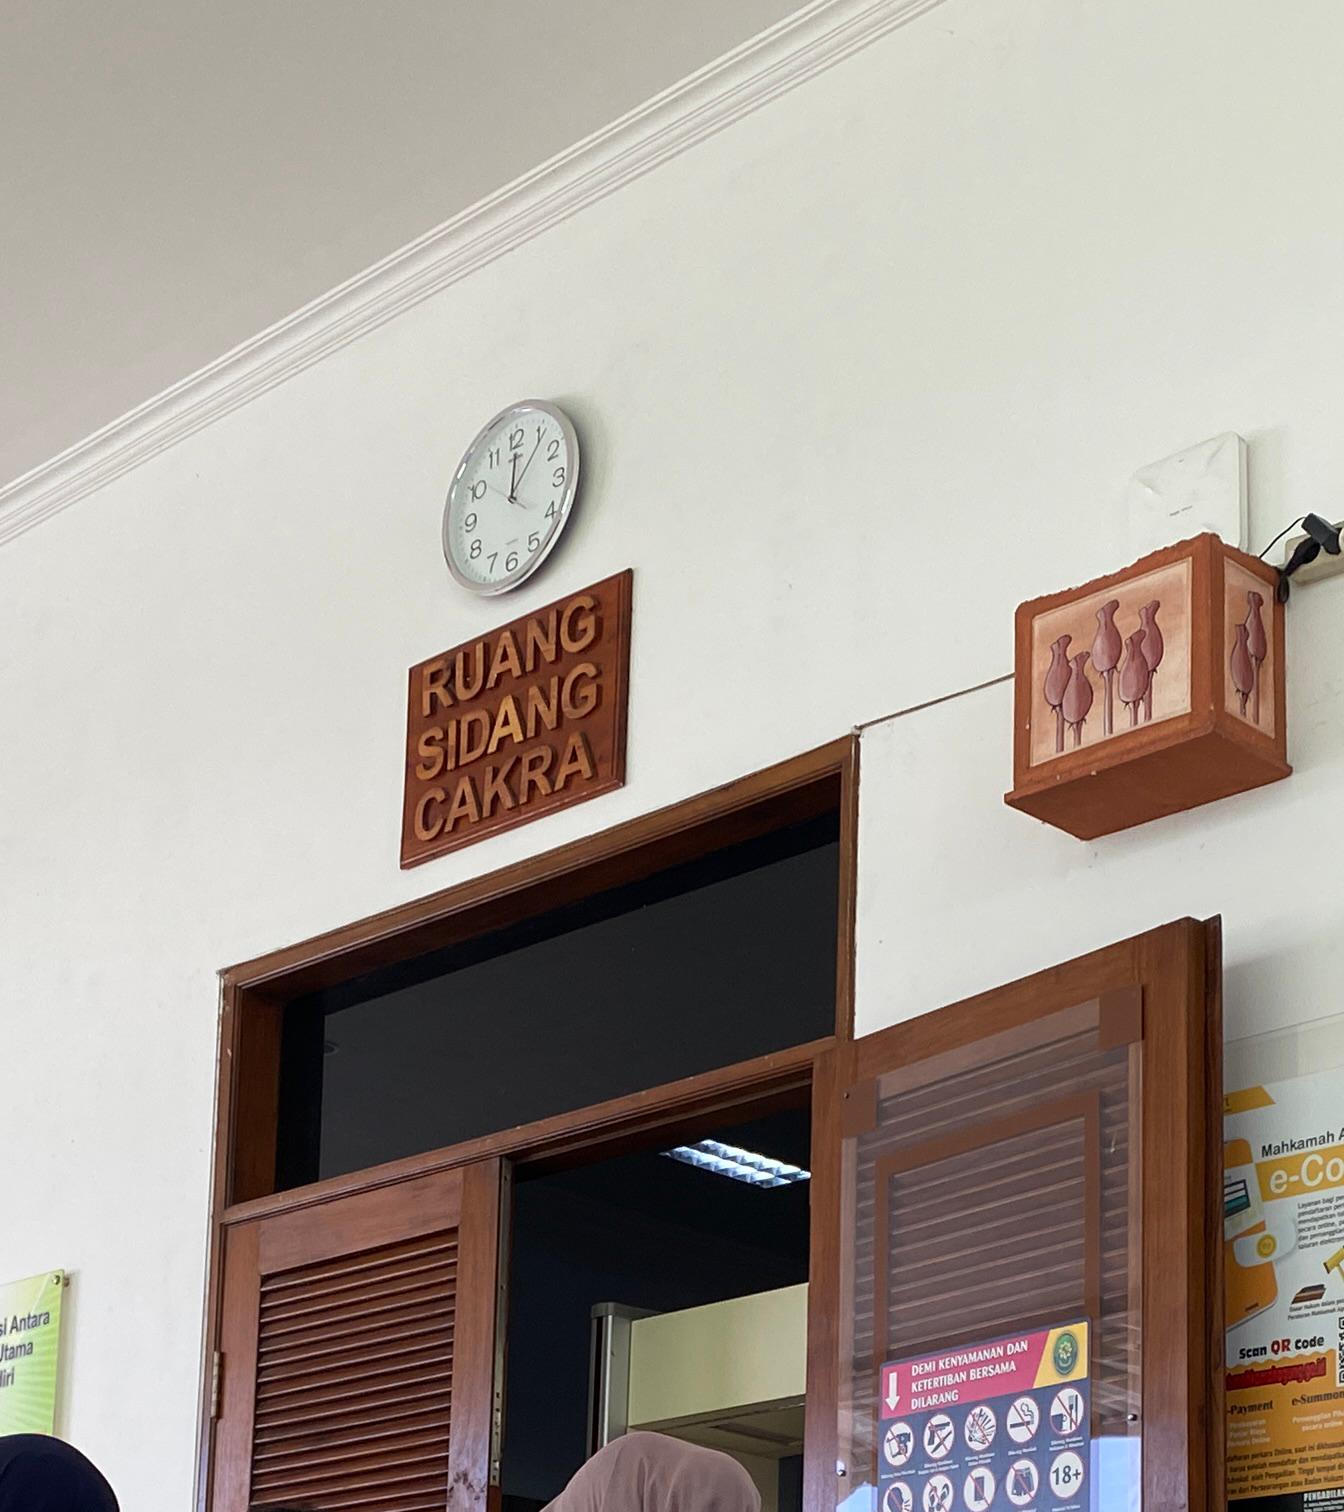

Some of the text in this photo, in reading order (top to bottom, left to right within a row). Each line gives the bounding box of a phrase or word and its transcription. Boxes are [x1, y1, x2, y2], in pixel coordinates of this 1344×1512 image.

[509, 428, 525, 451] 12
[488, 448, 500, 469] 11
[547, 440, 560, 462] 2
[552, 467, 565, 487] 3
[468, 480, 487, 502] 10
[544, 501, 557, 519] 4
[464, 513, 477, 532] 9
[470, 539, 482, 559] 8
[527, 531, 540, 552] 5
[487, 552, 498, 573] 7
[506, 552, 518, 572] 6
[422, 595, 597, 718] RUANG
[416, 662, 599, 780] SIDANG
[414, 731, 594, 841] CAKRA
[1261, 1130, 1335, 1158] Mahkamah
[10, 1311, 50, 1334] Antara
[911, 1340, 1028, 1376] DEMI KENYAMANAN DAN
[1239, 1335, 1325, 1360] Scan QR Code
[911, 1361, 1016, 1393] KETERTIBAN BERSAMA
[911, 1390, 959, 1410] DILARANG
[1227, 1399, 1274, 1416] -Payment
[1052, 1465, 1082, 1485] 18+
